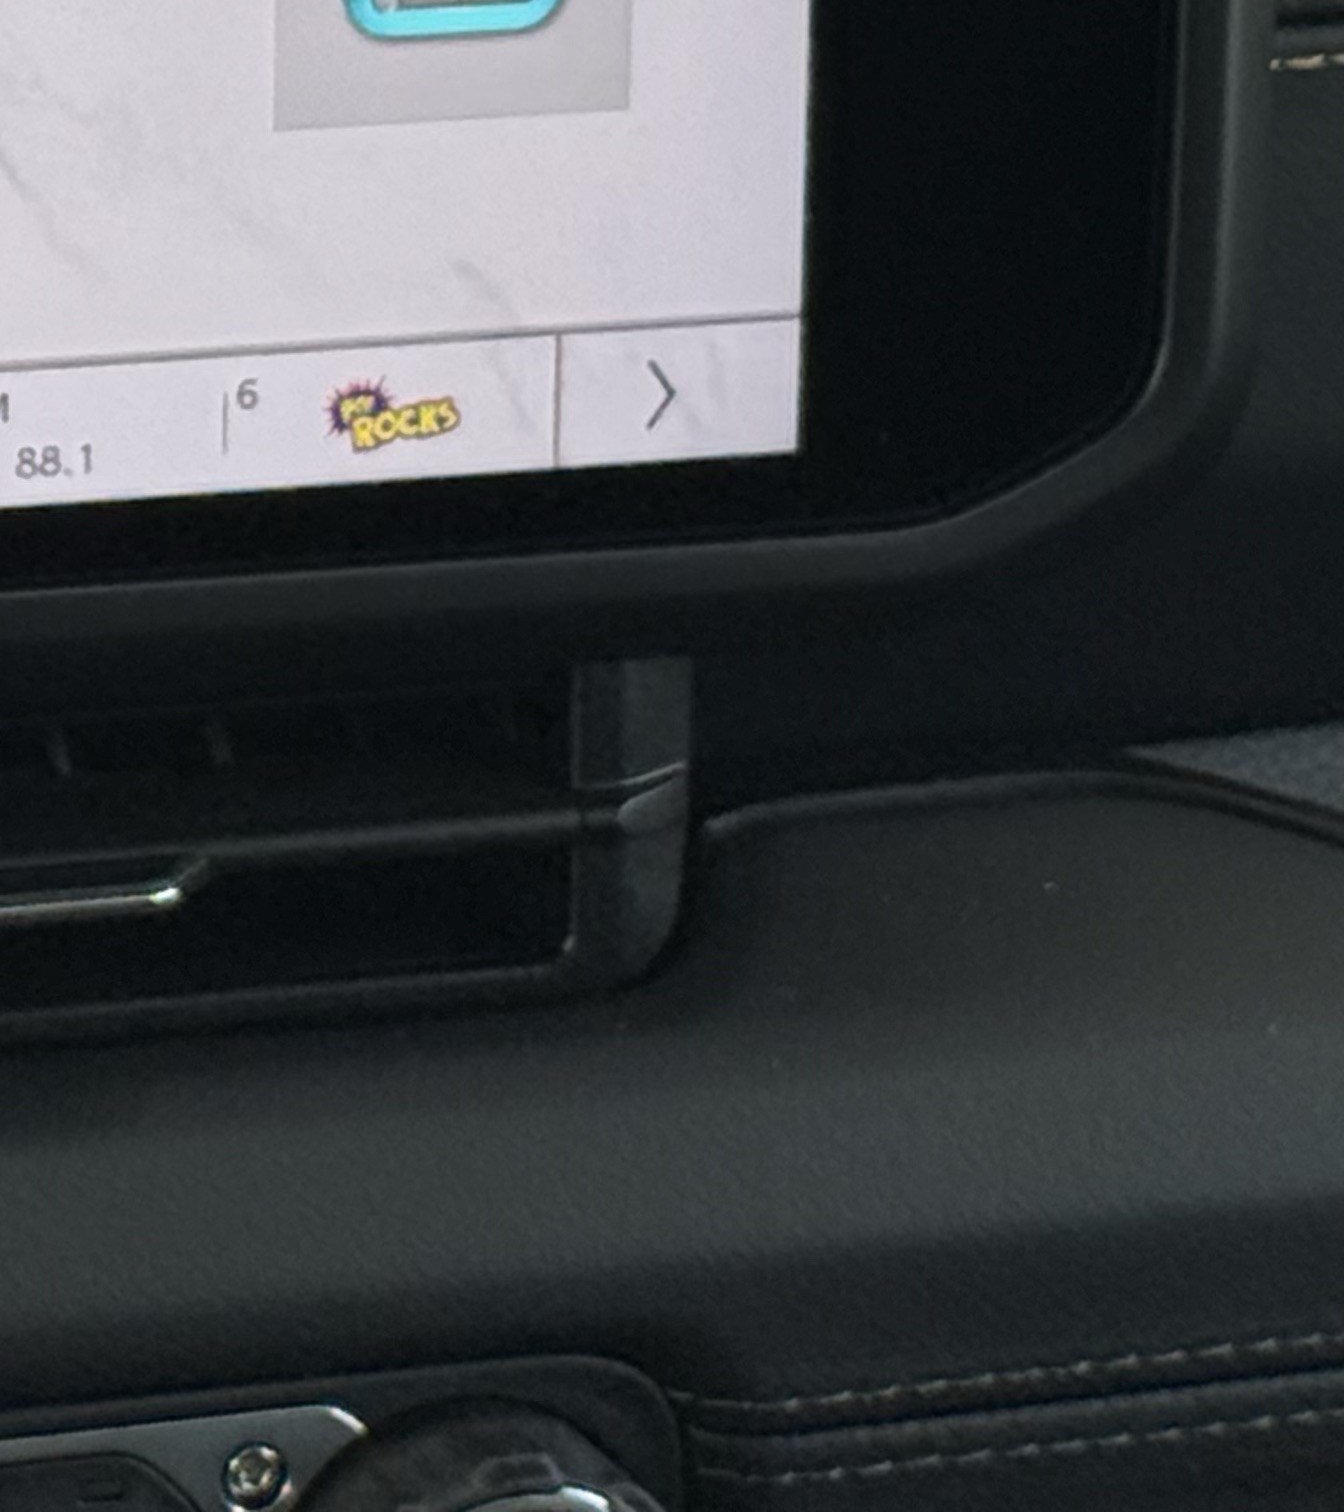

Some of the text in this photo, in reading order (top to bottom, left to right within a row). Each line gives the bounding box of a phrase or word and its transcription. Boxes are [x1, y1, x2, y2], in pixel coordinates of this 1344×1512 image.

[236, 379, 258, 410] 6
[352, 396, 457, 450] ROCKS
[14, 444, 93, 480] 88.1
